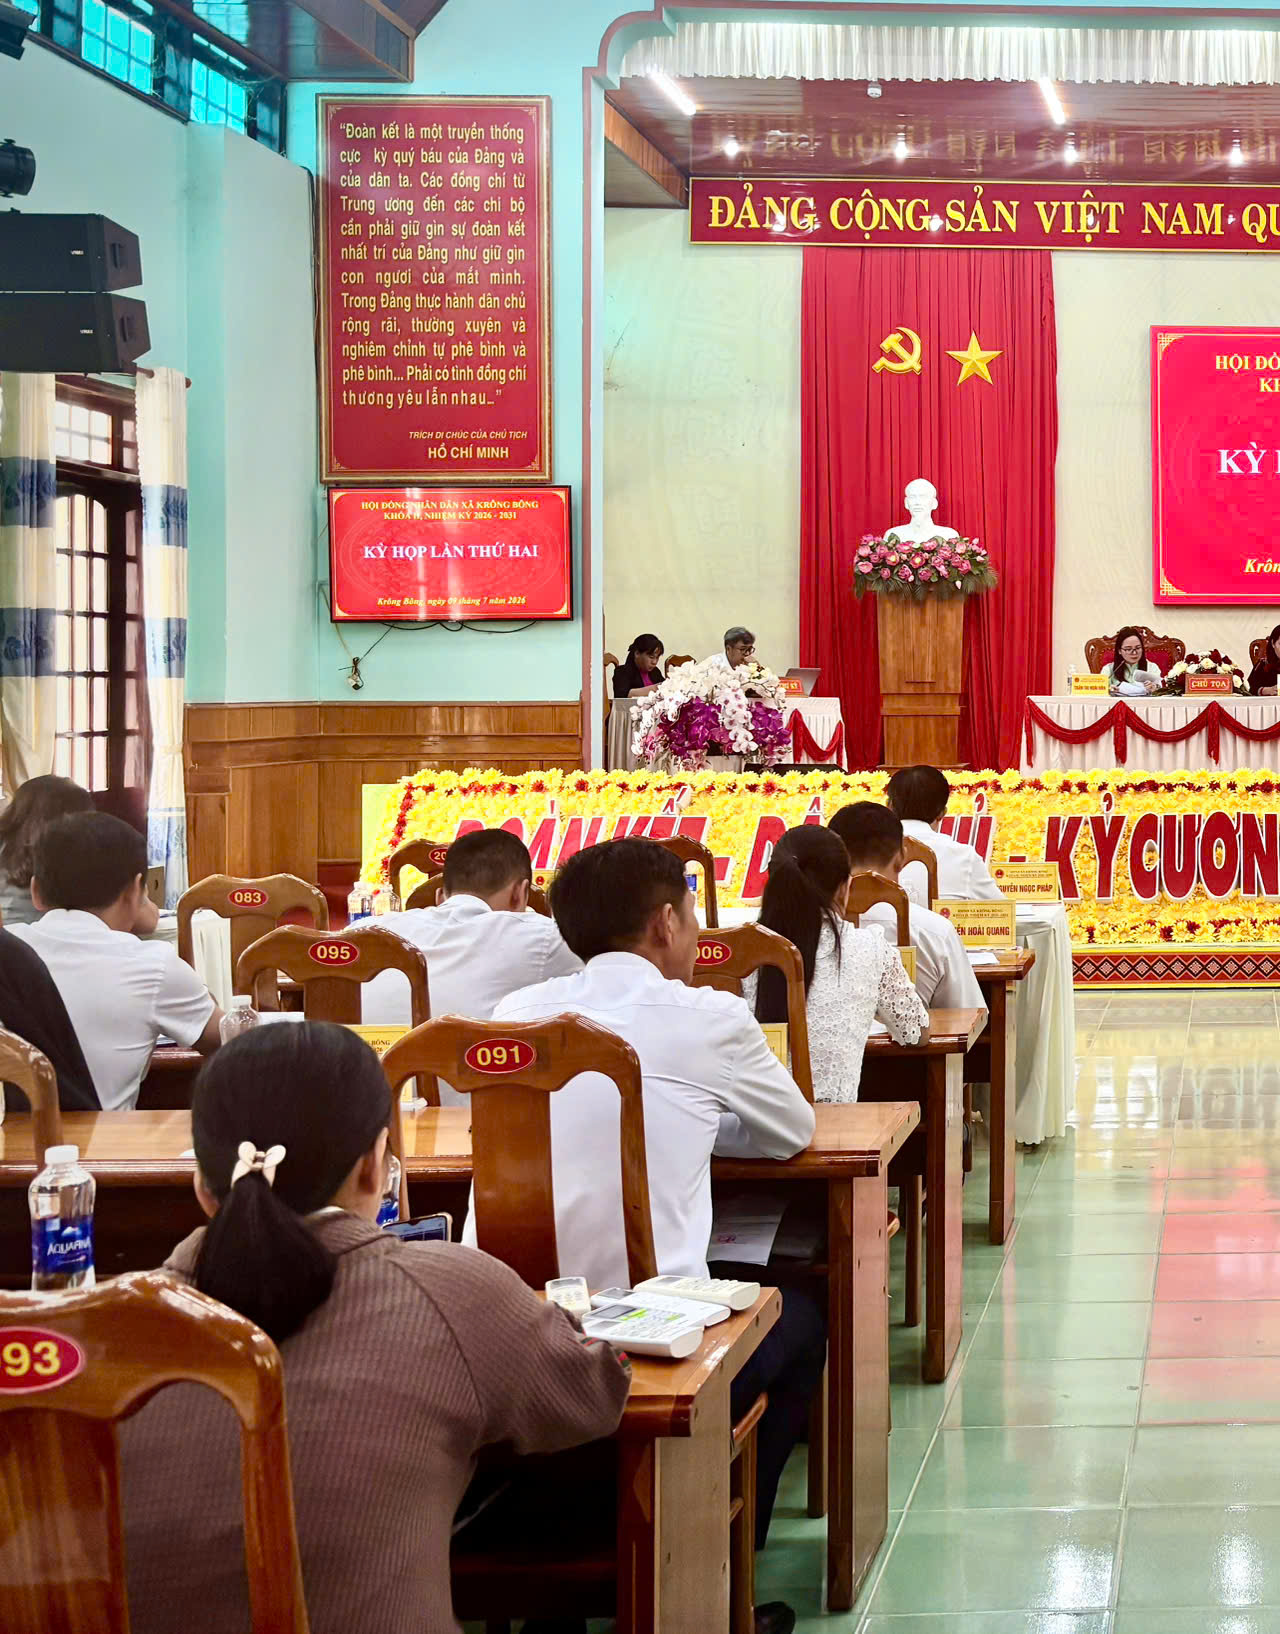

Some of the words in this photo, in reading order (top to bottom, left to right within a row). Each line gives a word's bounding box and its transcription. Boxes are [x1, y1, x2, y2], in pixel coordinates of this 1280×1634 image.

[340, 123, 376, 138] “Đoàn
[382, 121, 399, 138] kết
[405, 123, 414, 139] là
[421, 123, 442, 142] một
[448, 122, 484, 143] truyền
[490, 122, 523, 144] thống
[340, 149, 360, 165] cực
[374, 147, 387, 167] kỳ
[394, 147, 414, 167] quý
[421, 147, 442, 163] báu
[448, 146, 468, 163] của
[475, 146, 504, 168] Đảng
[511, 148, 524, 164] và
[340, 170, 360, 187] của
[369, 172, 390, 187] dân
[399, 173, 412, 187] ta.
[421, 172, 442, 187] Các
[451, 170, 480, 191] đồng
[488, 172, 505, 188] chí
[513, 173, 525, 188] từ
[340, 196, 375, 215] Trung
[385, 197, 413, 215] ương
[423, 194, 444, 211] đến
[454, 196, 474, 212] các
[484, 197, 500, 211] chi
[511, 197, 525, 215] bộ
[709, 183, 816, 230] ĐẢNG
[829, 190, 930, 239] CỘNG
[945, 185, 1018, 233] SẢN
[1034, 190, 1124, 242] VIỆT
[1141, 202, 1224, 235] NAM
[1216, 354, 1249, 373] HỘI
[409, 430, 433, 439] TRÍCH
[435, 431, 444, 439] DI
[446, 430, 469, 439] CHÚC
[471, 429, 487, 439] CỦA
[490, 429, 507, 439] CHỦ
[509, 431, 527, 440] TỊCH
[428, 443, 447, 459] HỒ
[451, 444, 473, 459] CHÍ
[476, 447, 509, 459] MINH
[1218, 442, 1266, 473] KỲ
[364, 543, 387, 558] KỲ
[393, 546, 427, 561] HỌP
[431, 543, 463, 558] LẦN
[468, 542, 505, 557] THỨ
[509, 545, 537, 557] HAI
[1045, 792, 1126, 899] KỶ
[234, 891, 261, 903] 083
[986, 926, 1010, 936] QUANG
[316, 945, 351, 961] 095
[476, 1045, 520, 1067] 091
[0, 1341, 61, 1377] 93
